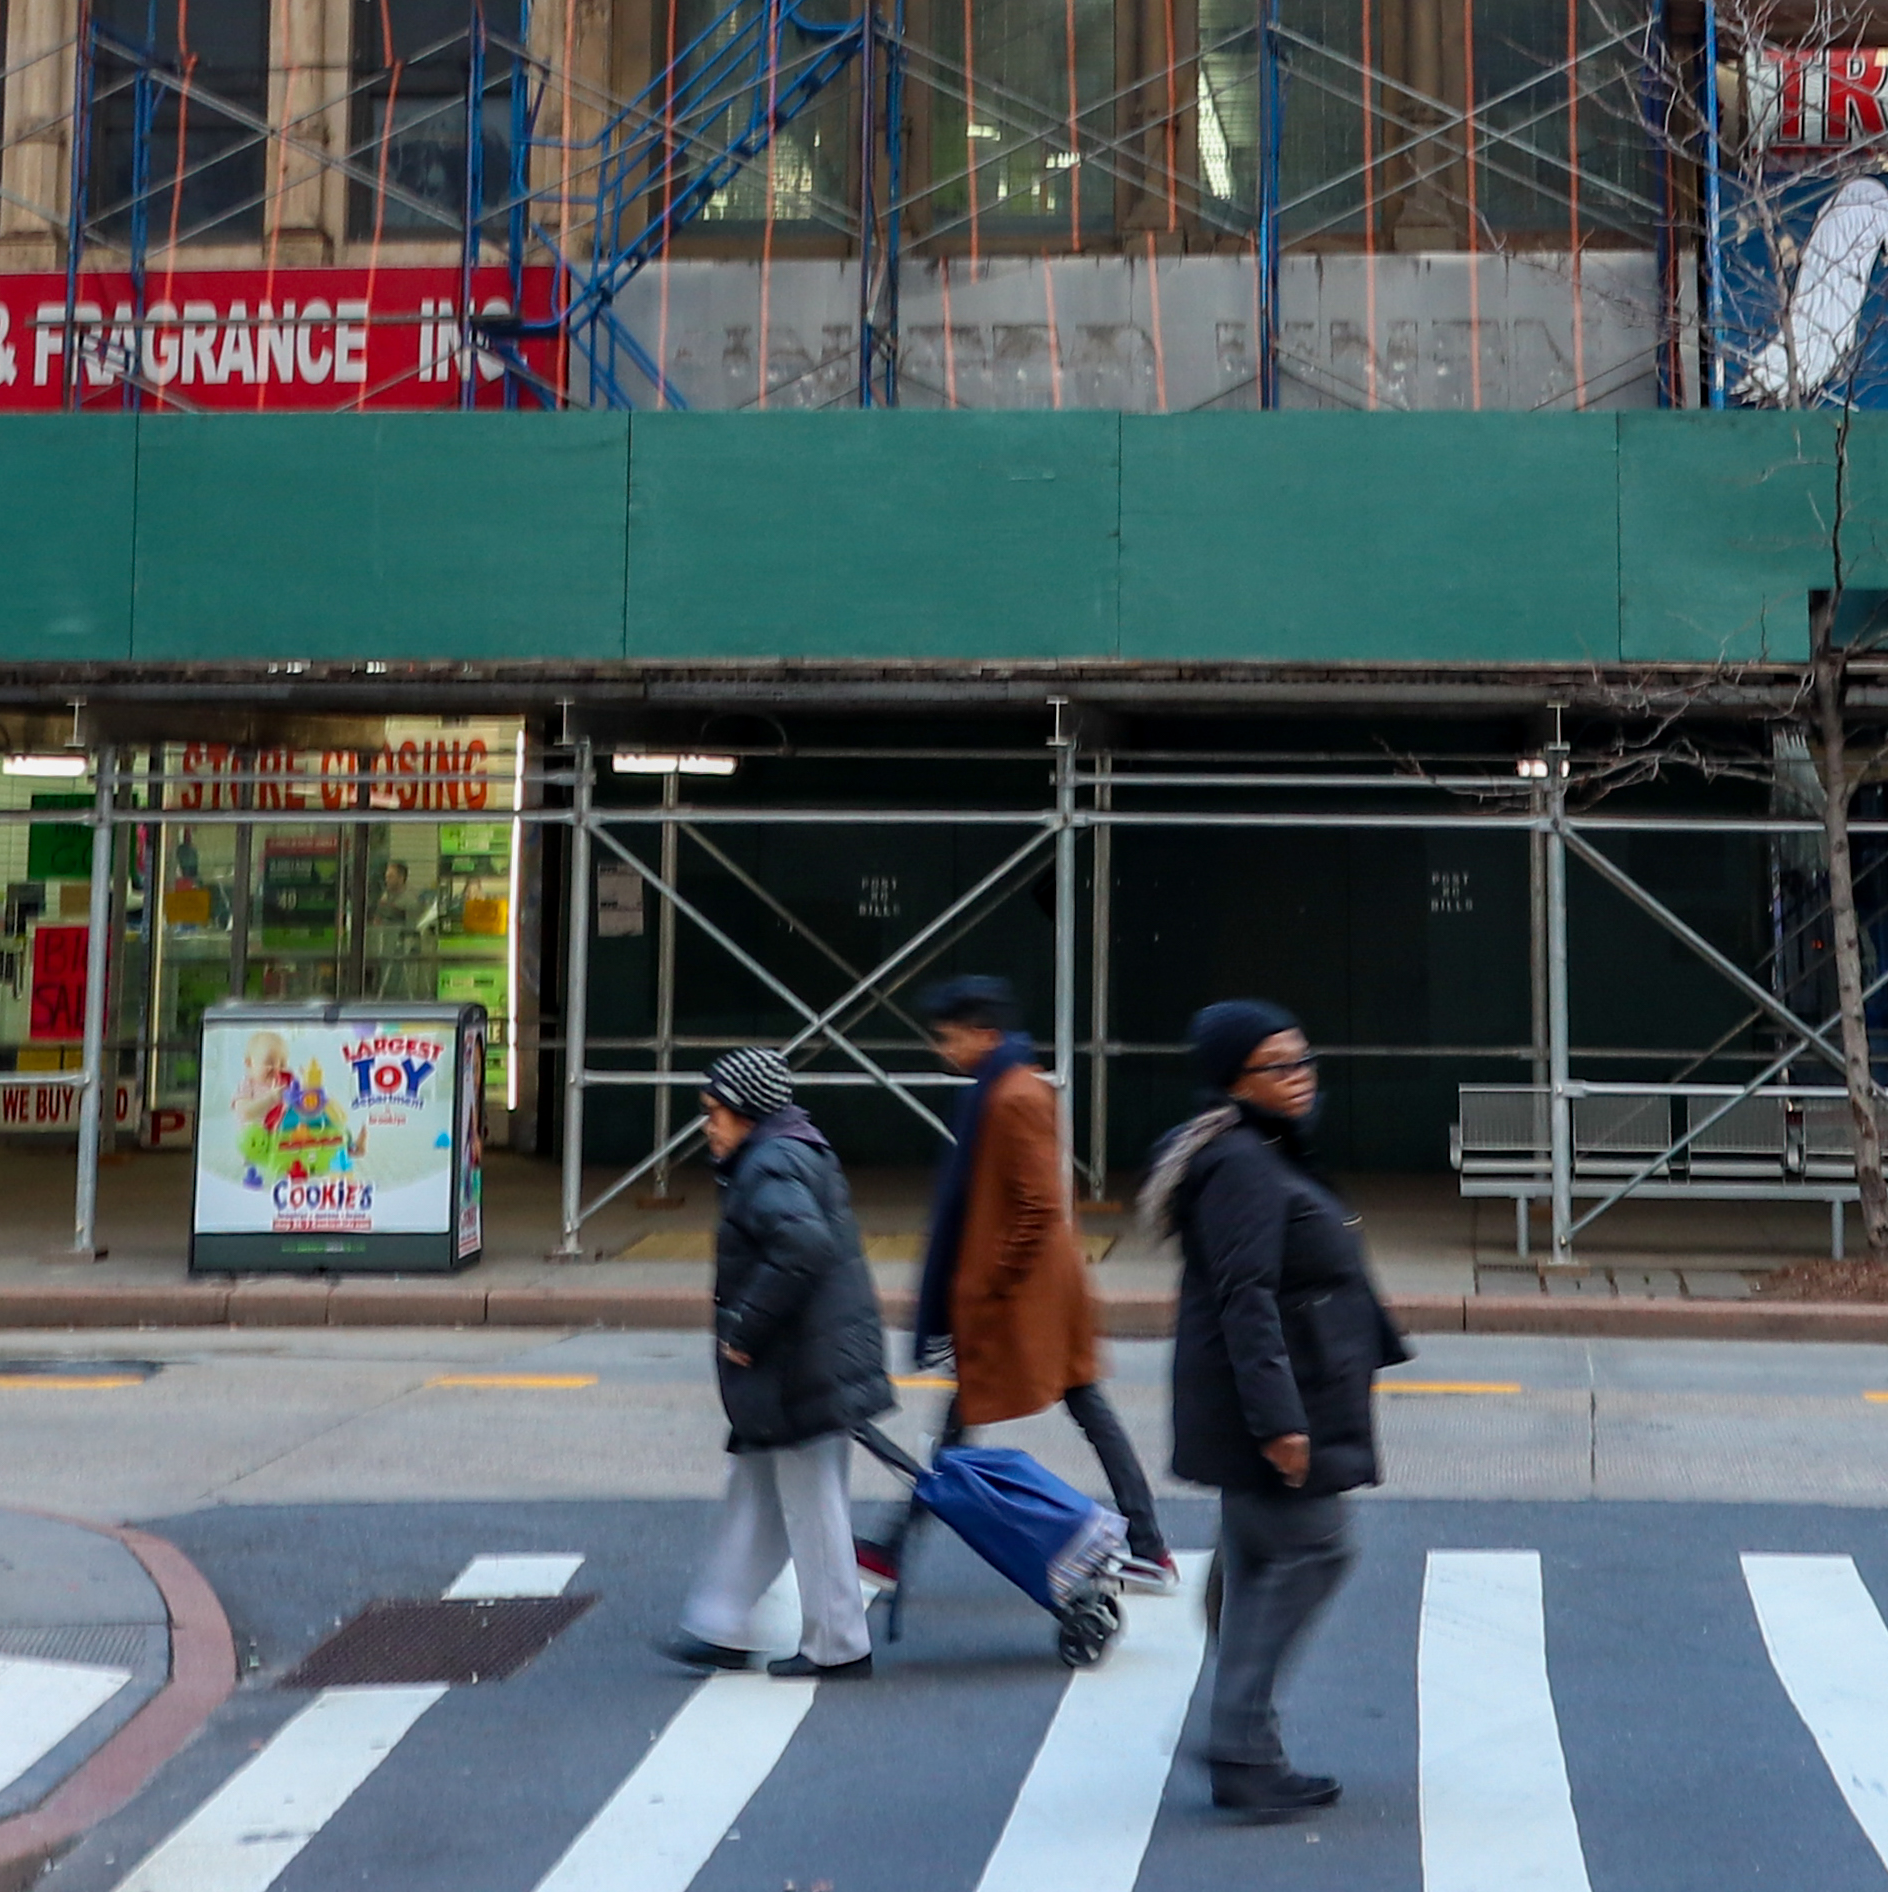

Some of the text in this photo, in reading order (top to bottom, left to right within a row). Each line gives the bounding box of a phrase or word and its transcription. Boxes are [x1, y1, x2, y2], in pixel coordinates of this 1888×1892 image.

[33, 296, 368, 386] FRAGRANCE
[45, 932, 88, 975] BI
[34, 985, 85, 1030] SAL
[342, 1036, 444, 1062] LARGEST
[352, 1056, 434, 1098] TOY
[3, 1085, 30, 1123] WE
[36, 1085, 74, 1122] BUY
